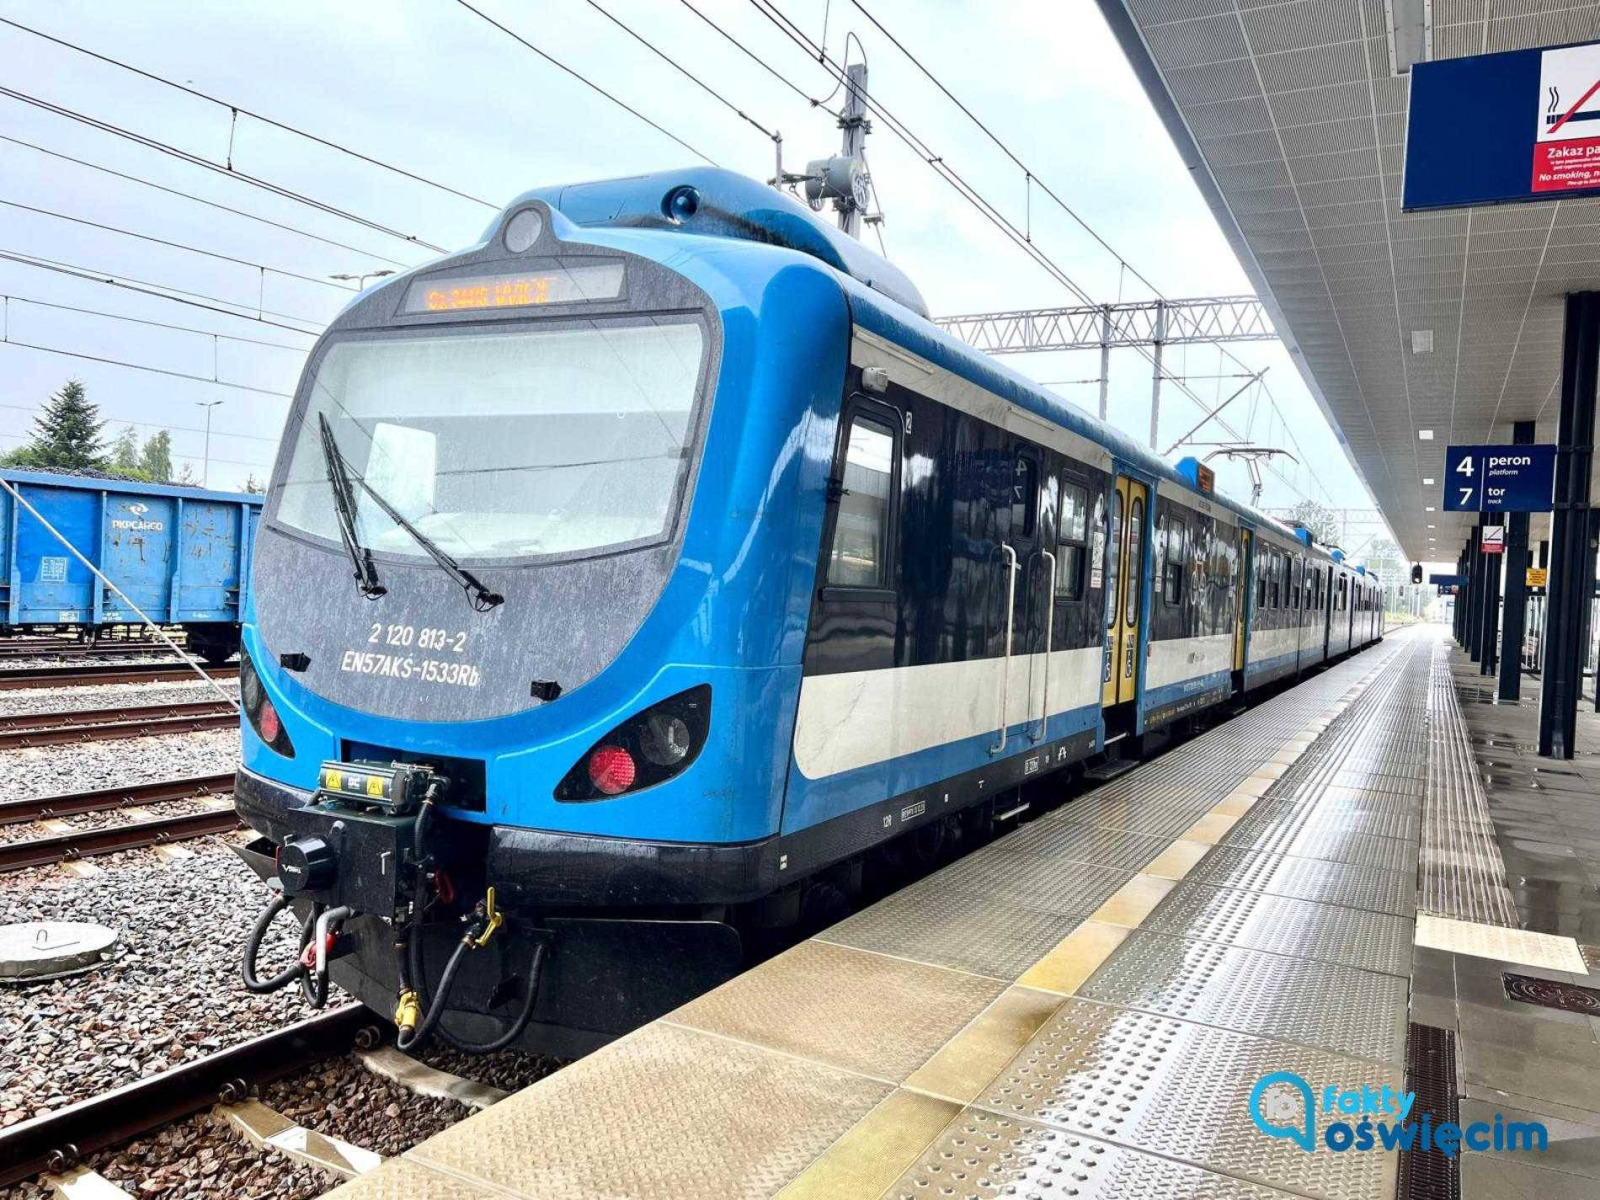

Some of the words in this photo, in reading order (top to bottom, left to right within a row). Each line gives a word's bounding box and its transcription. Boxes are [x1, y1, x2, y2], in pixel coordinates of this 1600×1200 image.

[1547, 146, 1583, 158] Zakaz
[1539, 174, 1552, 182] No
[1456, 456, 1474, 477] 4
[1489, 456, 1531, 469] peron
[1488, 468, 1519, 477] platform
[1459, 487, 1473, 505] 7
[1487, 486, 1506, 496] tor
[368, 622, 382, 643] 2
[386, 623, 414, 646] 120
[418, 627, 467, 653] 813-2
